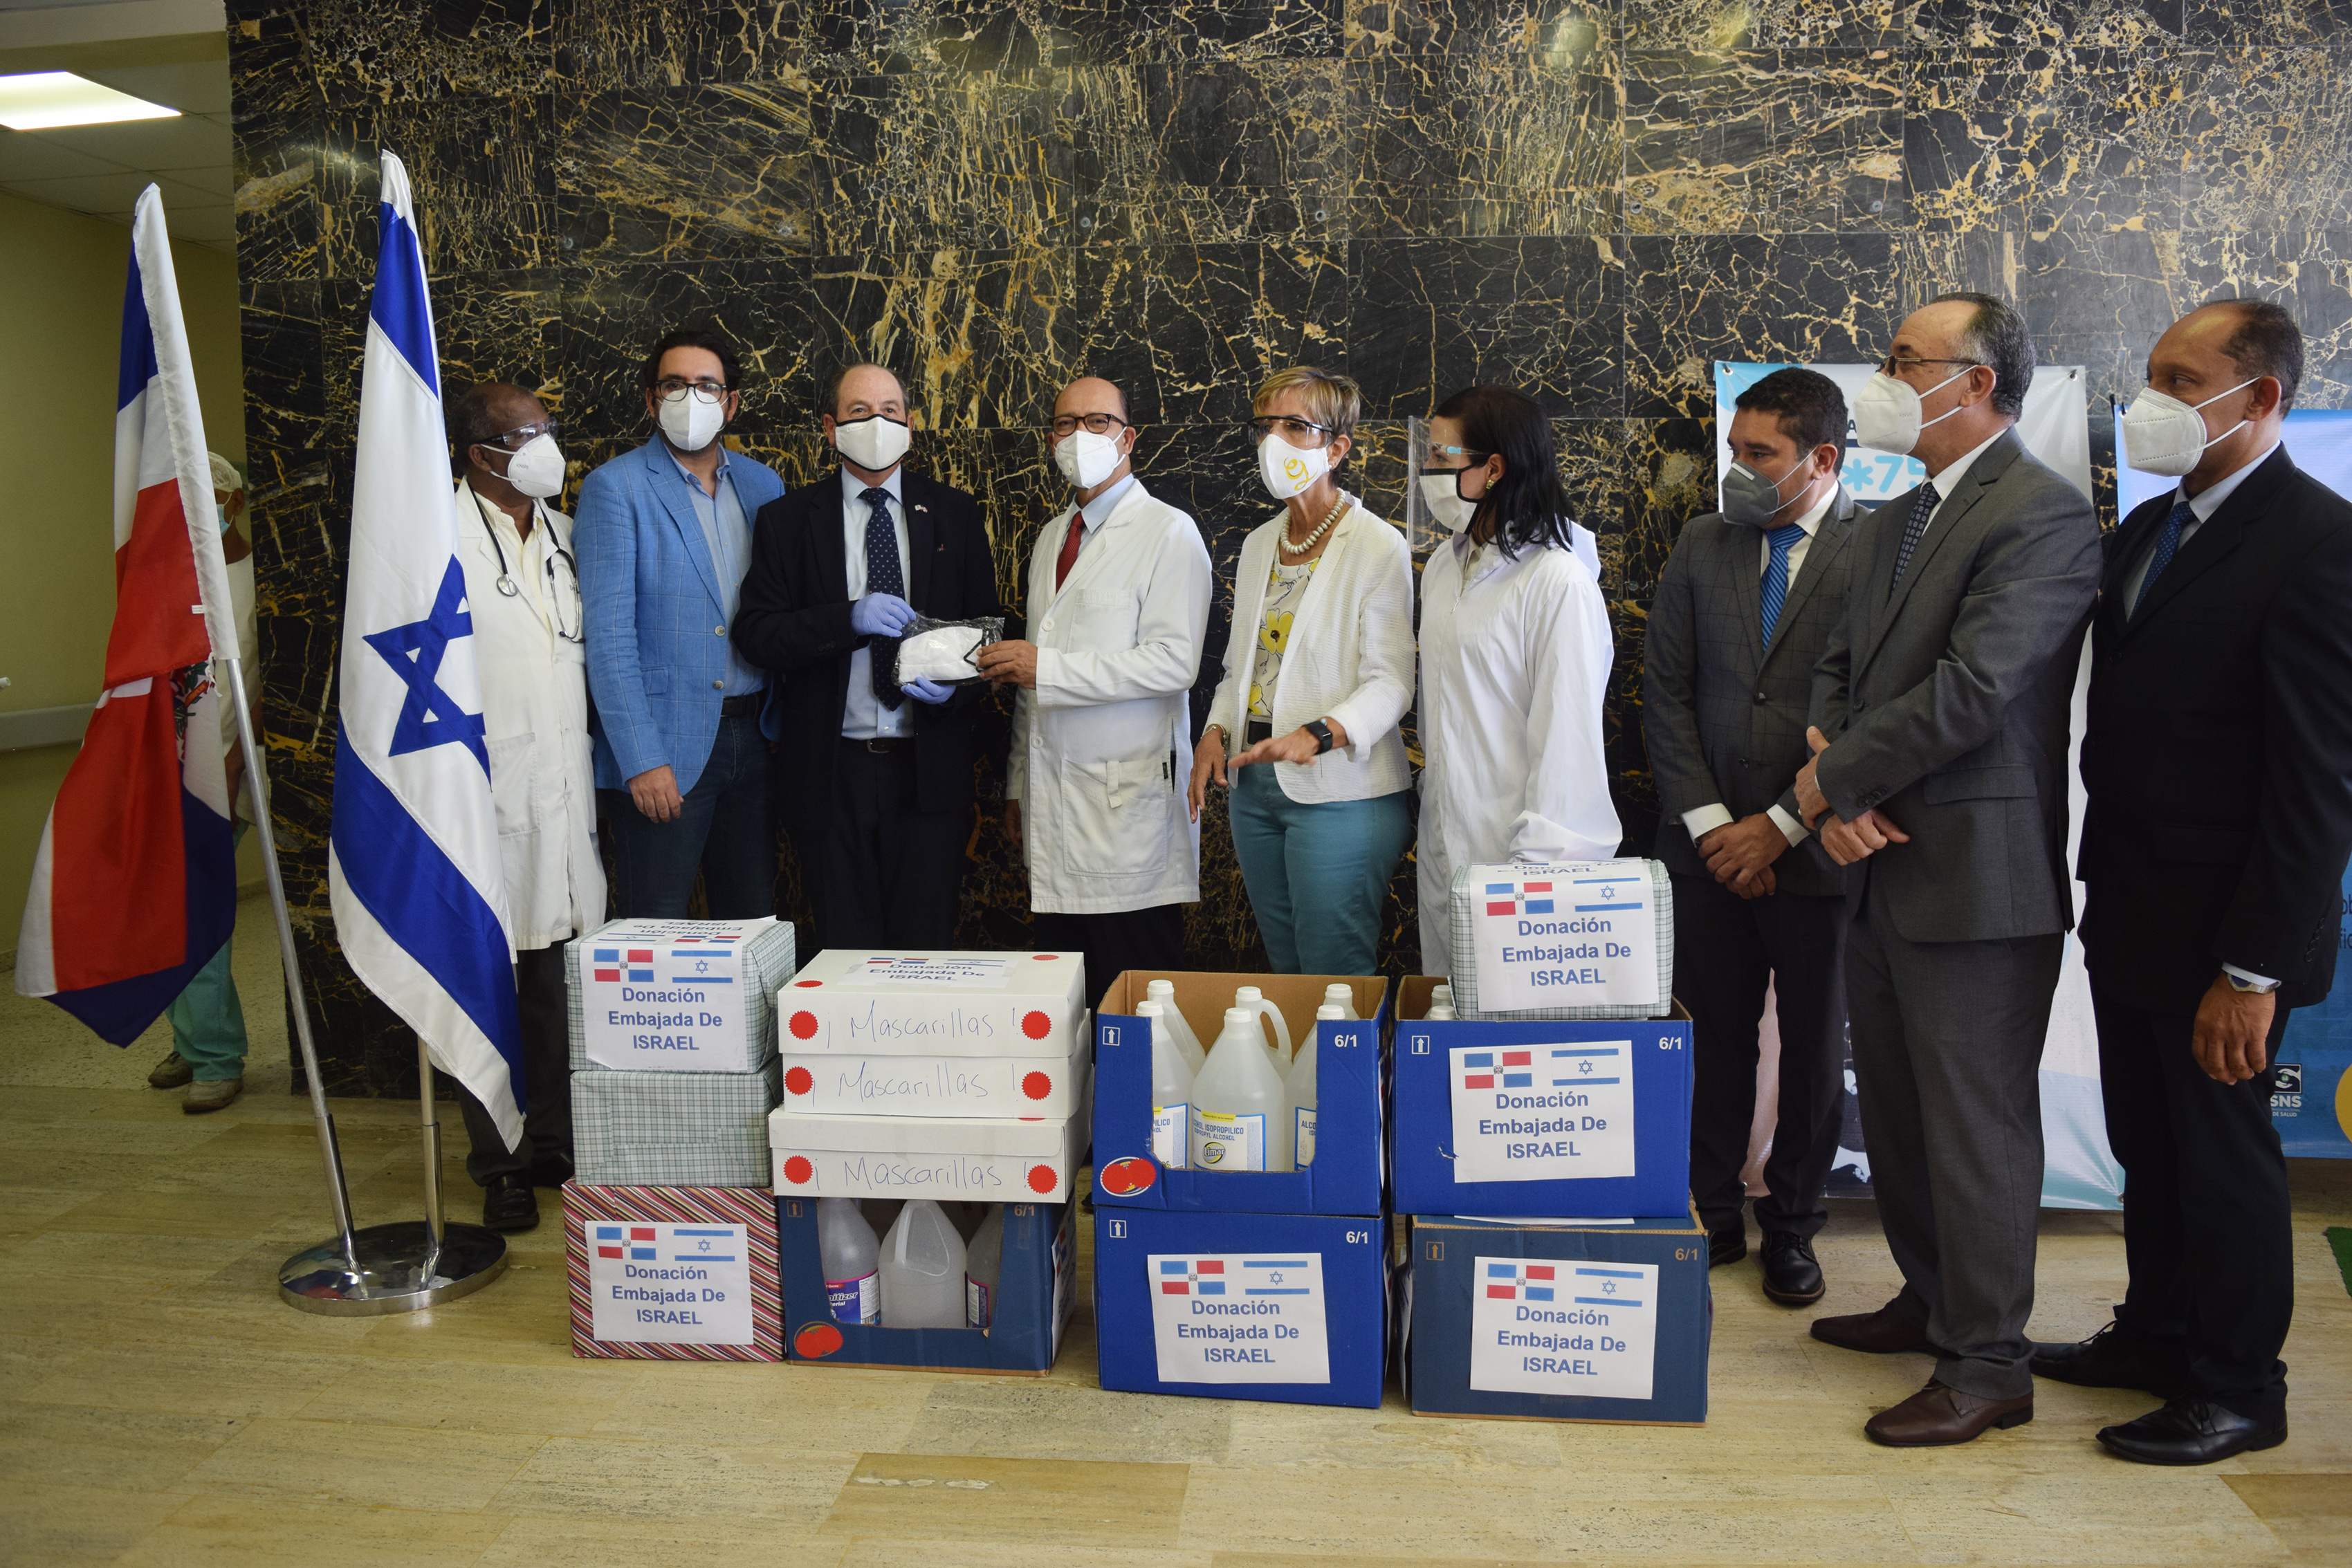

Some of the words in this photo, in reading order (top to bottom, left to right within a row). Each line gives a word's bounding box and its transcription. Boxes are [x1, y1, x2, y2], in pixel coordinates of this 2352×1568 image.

[1523, 867, 1598, 876] ISRAEL
[1519, 919, 1613, 937] Donación
[1503, 944, 1600, 964] Embajada
[1606, 943, 1632, 959] De
[1532, 969, 1606, 987] ISRAEL
[623, 988, 706, 1004] Donación
[609, 1011, 695, 1031] Embajada
[700, 1013, 723, 1028] De
[850, 999, 994, 1043] Mascarillas
[634, 1035, 699, 1051] ISRAEL
[1334, 1034, 1357, 1048] 6/1
[1659, 1037, 1682, 1050] 6/1
[838, 1060, 989, 1103] Mascarillas
[1496, 1090, 1590, 1110] Donación
[2270, 1095, 2302, 1108] SNS
[1205, 1123, 1244, 1135] ISOPROPILICO
[1480, 1118, 1576, 1138] Embajada
[1582, 1116, 1608, 1132] De
[1204, 1146, 1226, 1156] Limar
[1507, 1142, 1582, 1159] ISRAEL
[844, 1156, 1002, 1190] Mascarillas
[1014, 1204, 1035, 1217] 6/1
[1345, 1230, 1368, 1244] 6/1
[1675, 1248, 1698, 1261] 6/1
[625, 1265, 708, 1281] Donación
[612, 1286, 697, 1306] Embajada
[702, 1289, 726, 1303] De
[1192, 1299, 1280, 1316] Donación
[1516, 1304, 1610, 1327] Donación
[636, 1309, 703, 1325] ISRAEL
[1177, 1323, 1268, 1343] Embajada
[1274, 1324, 1300, 1339] De
[1498, 1330, 1594, 1352] Embajada
[1601, 1336, 1626, 1353] De
[1204, 1347, 1276, 1364] ISRAEL
[1523, 1357, 1598, 1376] ISRAEL
